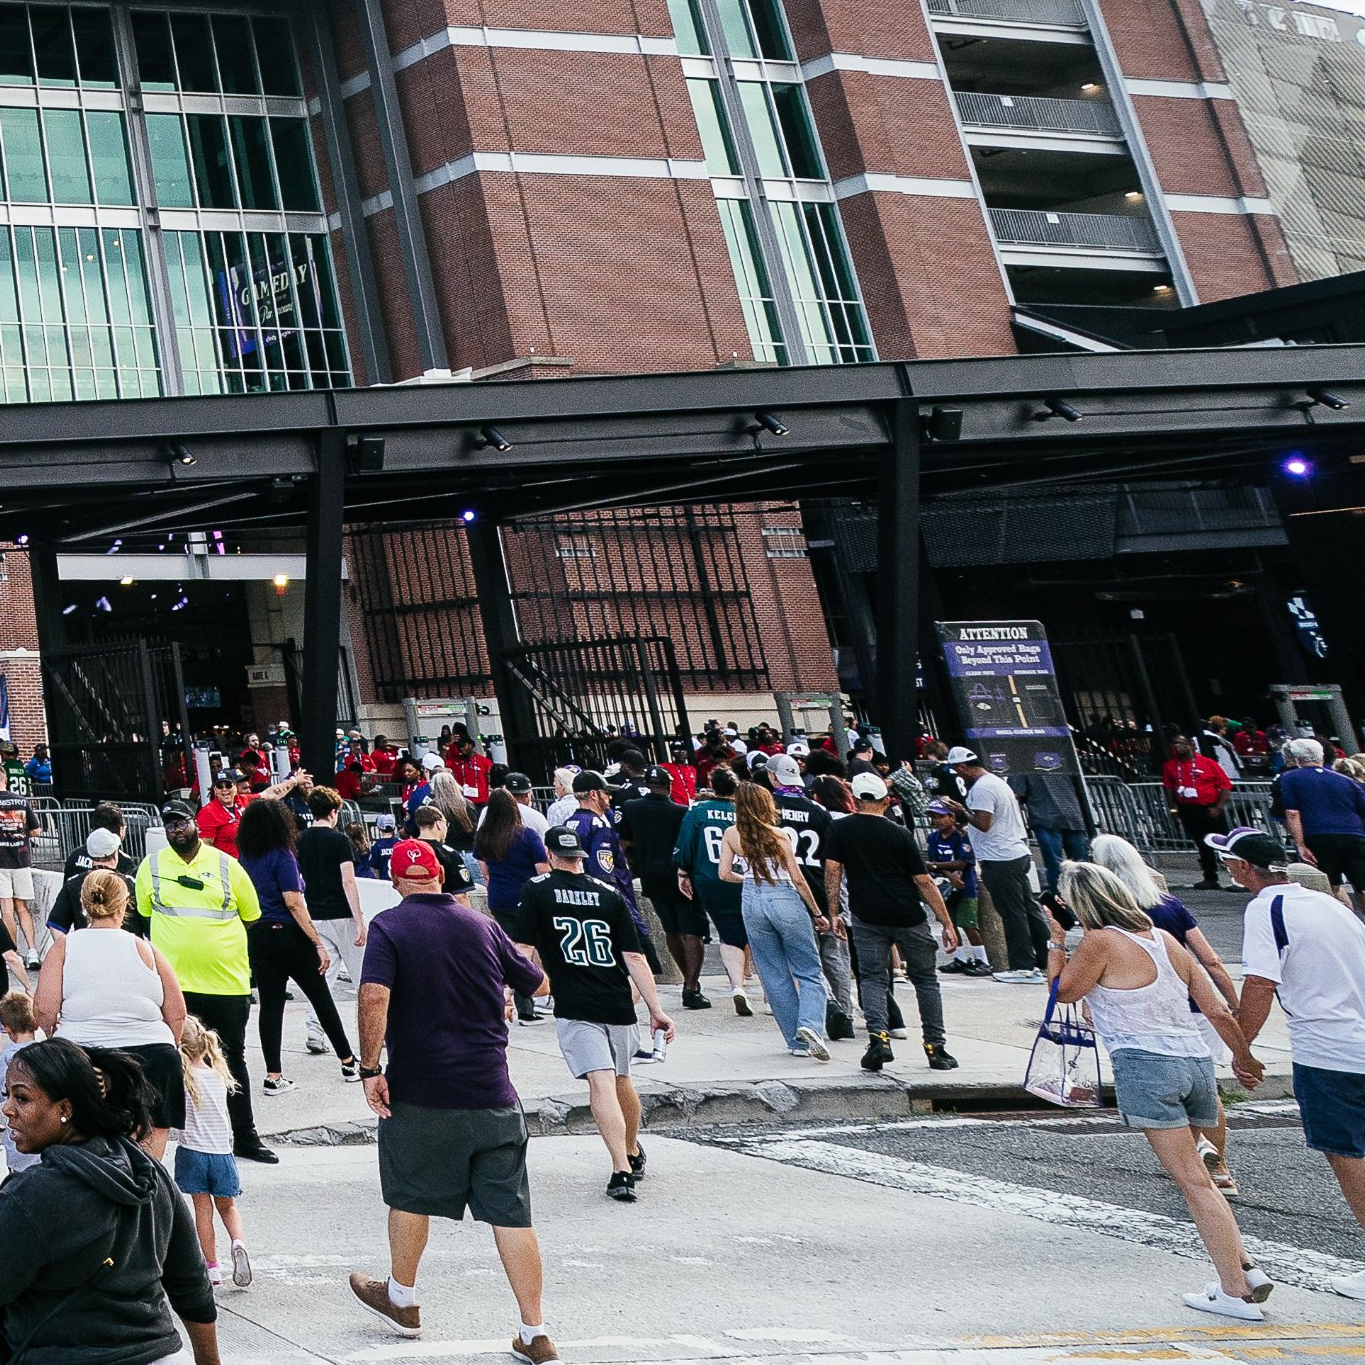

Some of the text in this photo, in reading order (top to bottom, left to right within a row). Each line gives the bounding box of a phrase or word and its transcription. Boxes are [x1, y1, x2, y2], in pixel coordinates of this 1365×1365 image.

[959, 627, 1029, 641] ATTENTION
[955, 644, 1042, 656] Only Approved Bags
[961, 654, 1041, 666] Beyond This Point
[782, 808, 810, 823] HENRY
[554, 889, 600, 906] BARKLEY
[553, 916, 617, 967] 26
